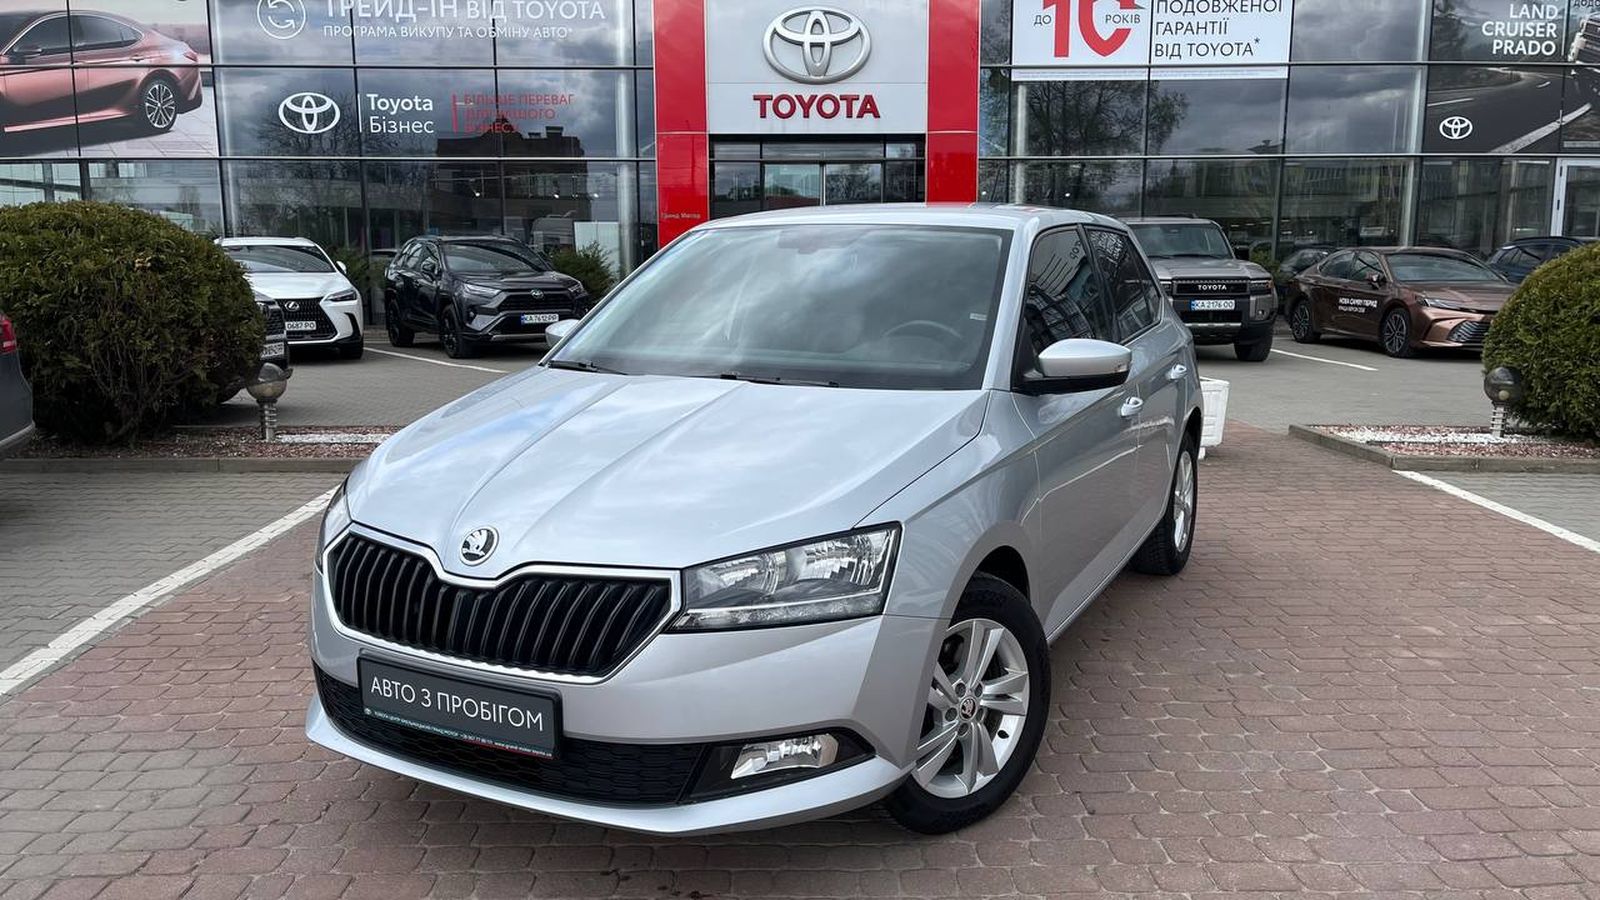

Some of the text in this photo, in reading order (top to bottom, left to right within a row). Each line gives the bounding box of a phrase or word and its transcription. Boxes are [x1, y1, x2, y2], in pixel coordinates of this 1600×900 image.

[466, 0, 507, 22] ВІД
[513, 0, 606, 19] TOYOTA
[1509, 3, 1559, 20] LAND
[1034, 14, 1053, 26] ДО
[1105, 14, 1141, 24] РОКІВ
[1155, 17, 1229, 35] ГАРАНТІЇ
[323, 25, 397, 37] ПРОГРАМА
[400, 26, 455, 38] ВИКУПУ
[457, 27, 473, 37] ТА
[476, 27, 530, 38] ОБМІНУ
[1481, 21, 1558, 38] CRUISER
[1154, 43, 1182, 60] ВІД
[1492, 39, 1556, 56] PRADO
[366, 93, 434, 115] Toyota
[753, 94, 880, 119] TOYOTA
[370, 116, 434, 133] Бізнес
[371, 676, 415, 703] АВТО
[437, 692, 543, 732] ПРОБІГОМ
